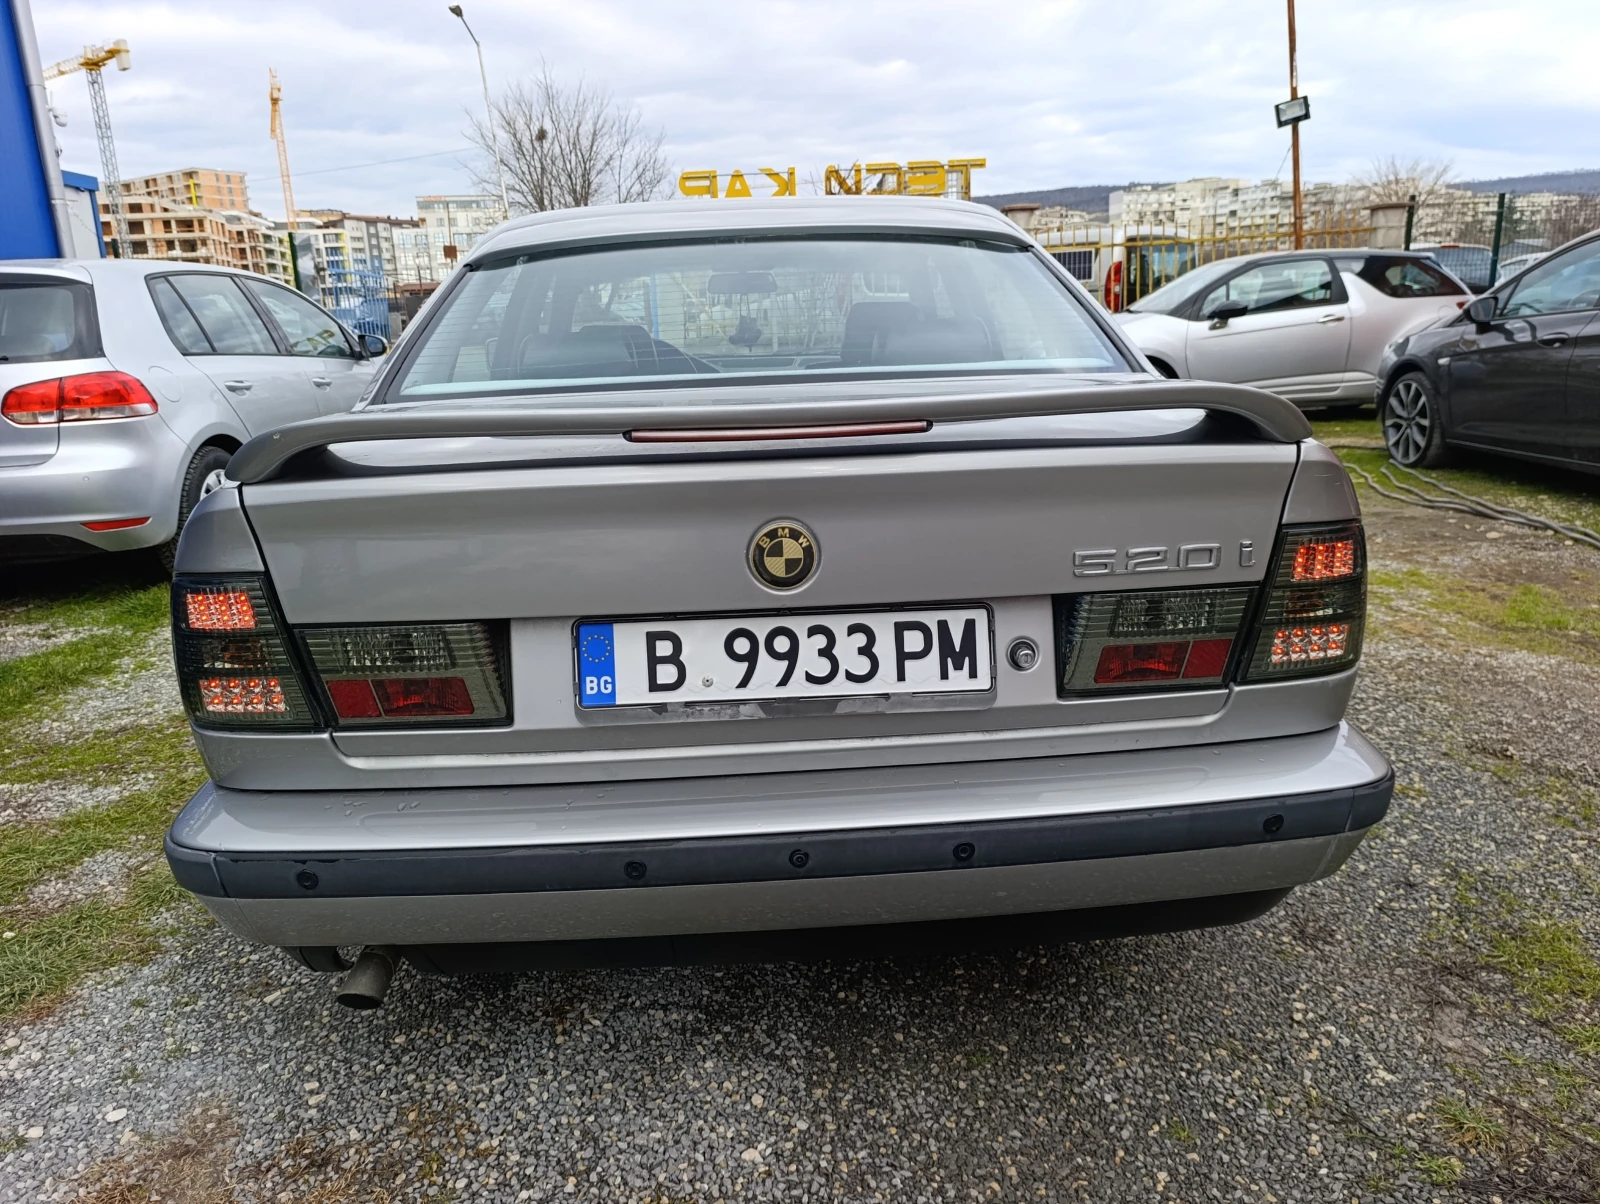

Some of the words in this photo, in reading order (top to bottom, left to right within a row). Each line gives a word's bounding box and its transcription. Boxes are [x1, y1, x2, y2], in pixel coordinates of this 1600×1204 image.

[757, 527, 810, 549] BMW
[645, 630, 687, 693] B
[723, 622, 880, 689] 9933
[893, 617, 979, 683] PM
[585, 675, 613, 695] BG
